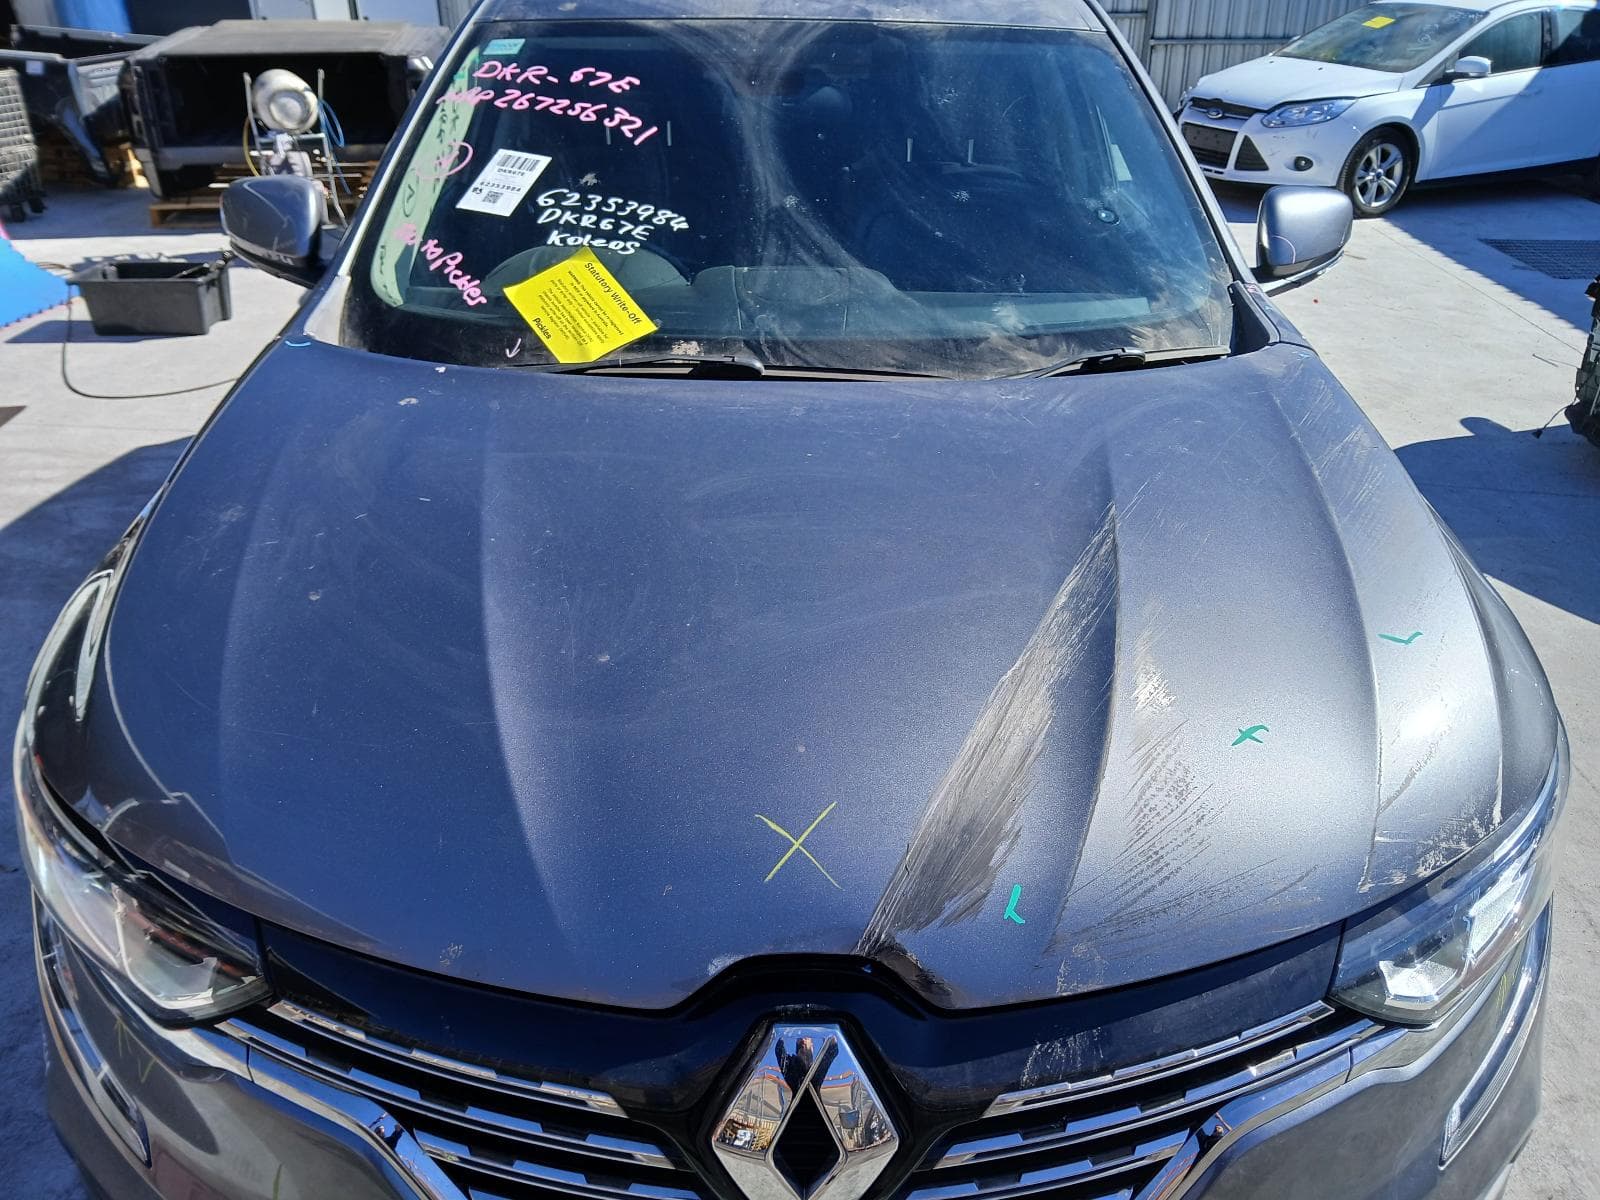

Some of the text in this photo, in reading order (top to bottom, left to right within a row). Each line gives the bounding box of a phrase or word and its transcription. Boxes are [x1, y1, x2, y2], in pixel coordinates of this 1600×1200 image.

[536, 208, 655, 241] DKR67E
[584, 262, 613, 293] Statutory
[611, 291, 643, 325] Write-Off
[533, 317, 552, 340] Pickles
